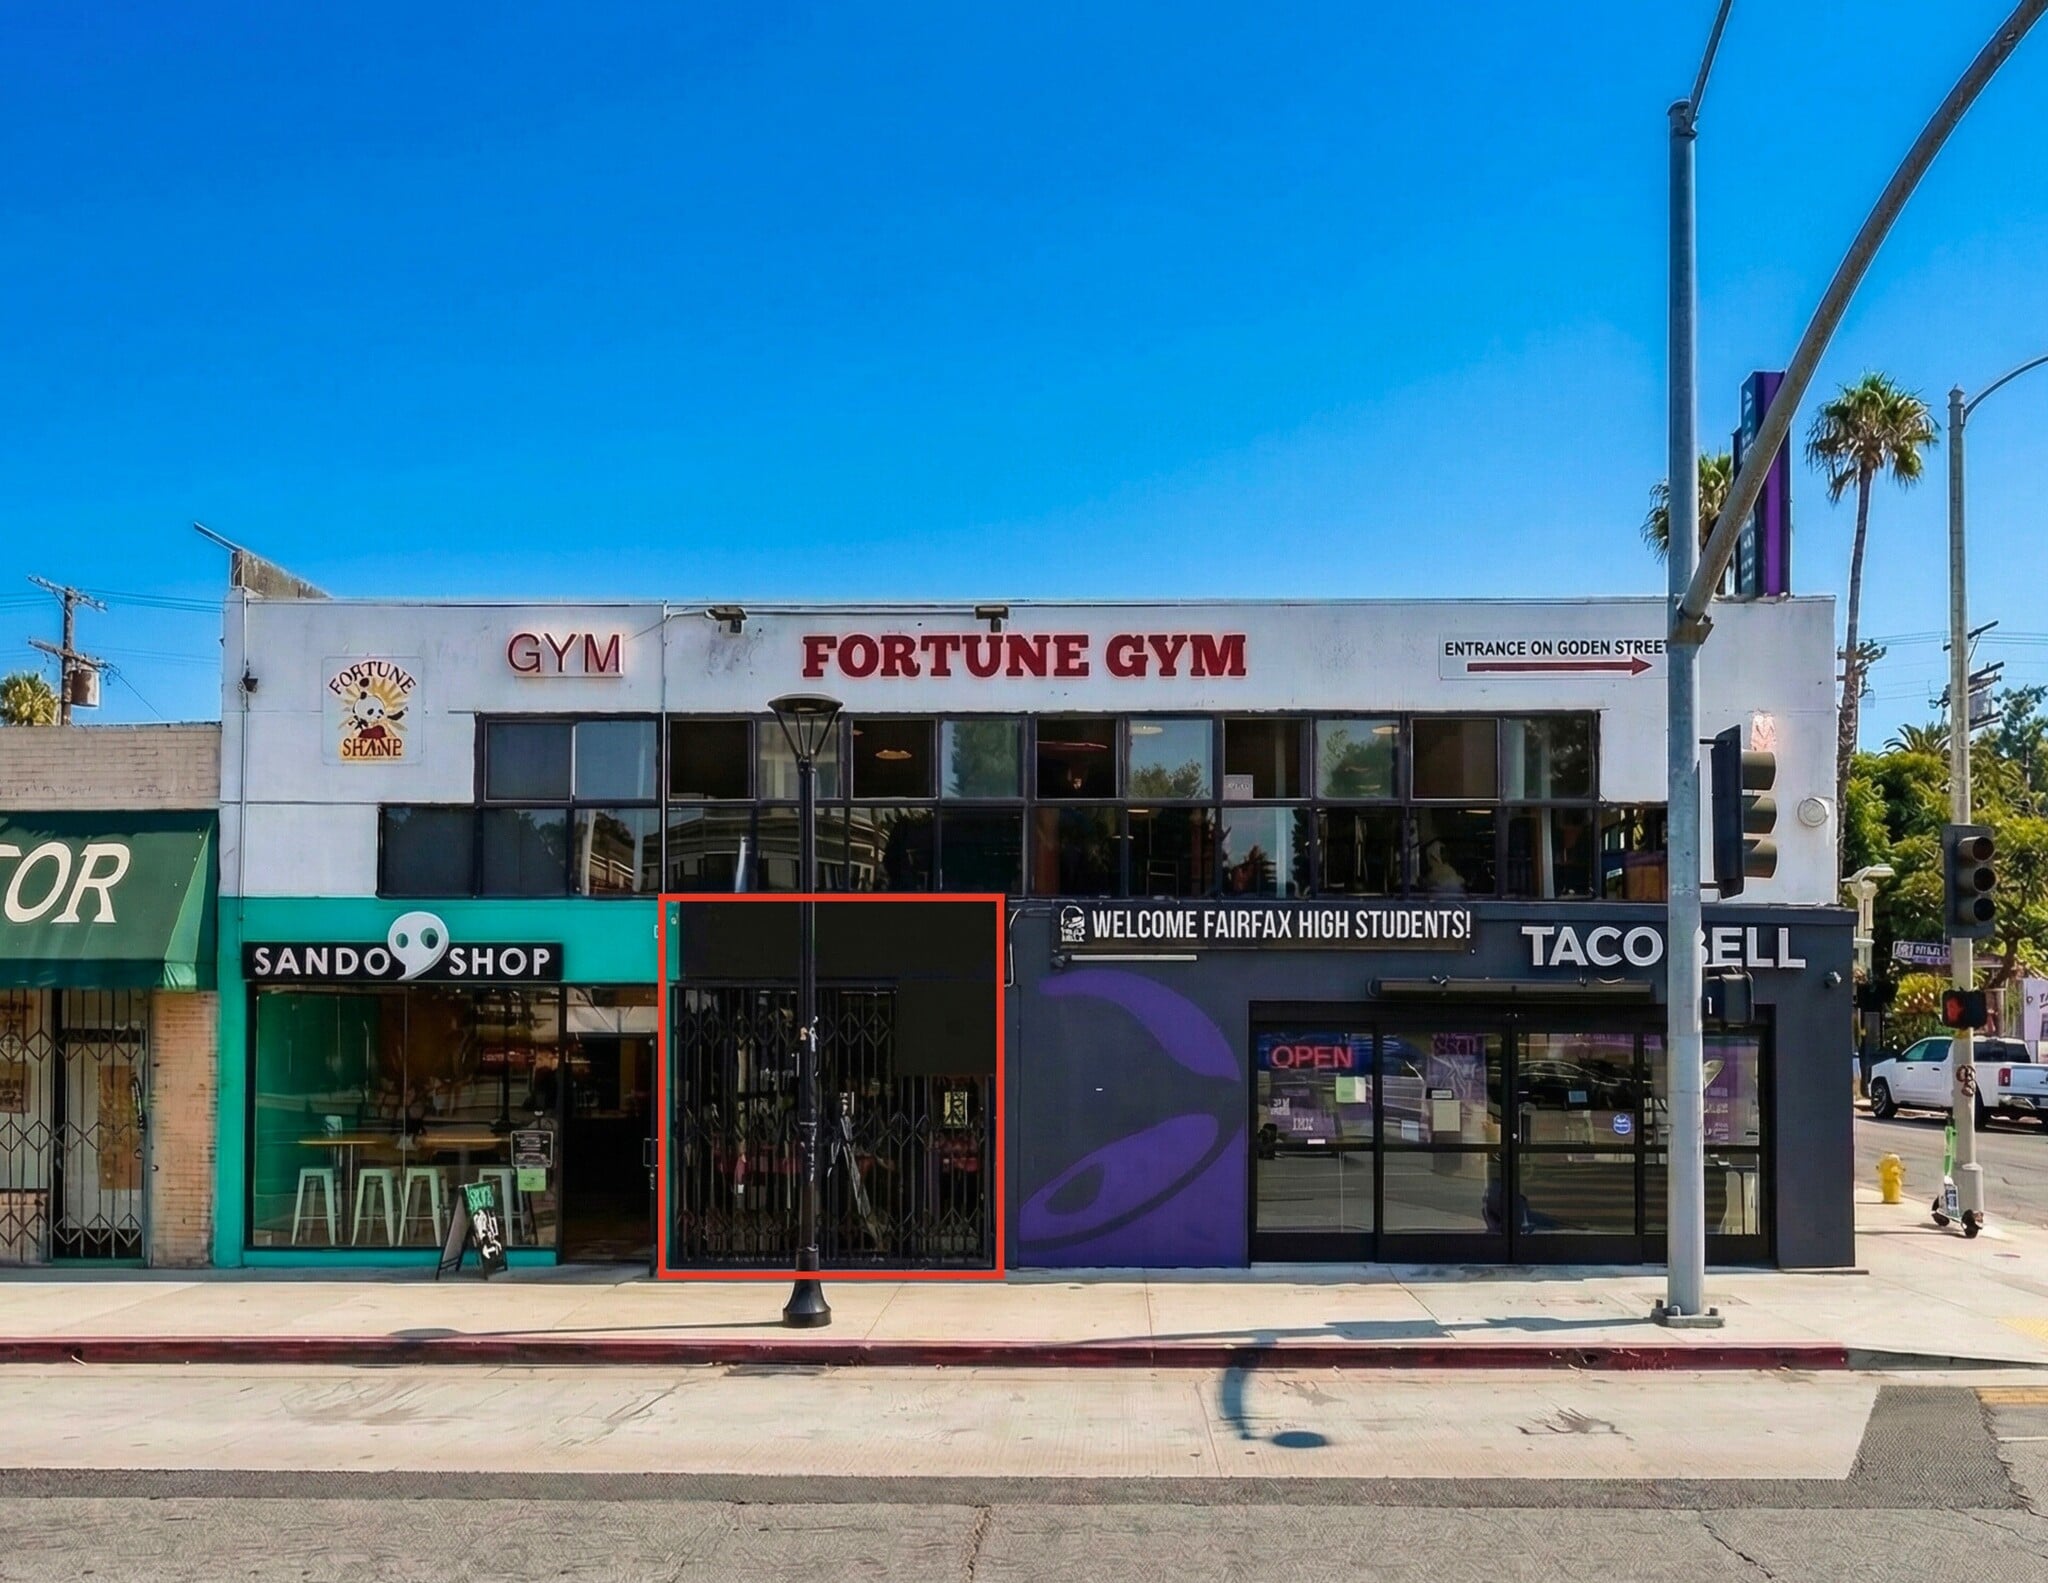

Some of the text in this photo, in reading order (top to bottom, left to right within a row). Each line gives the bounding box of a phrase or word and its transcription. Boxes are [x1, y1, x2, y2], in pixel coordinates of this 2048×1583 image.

[507, 633, 624, 675] GYM
[803, 634, 1247, 677] FORTUNE GYM
[1445, 641, 1526, 656] ENTRANCE
[1530, 640, 1553, 656] ON
[1557, 640, 1610, 655] GODEN
[329, 661, 416, 695] FORTUNE
[1092, 910, 1197, 939] WELCOME
[1204, 910, 1292, 939] FAIRFAX
[1299, 910, 1348, 939] HIGH
[1355, 910, 1471, 939] STUDENTS!
[253, 945, 551, 976] SANDO SHOP
[1521, 925, 1664, 968] TACO
[1271, 1045, 1353, 1069] OPEN
